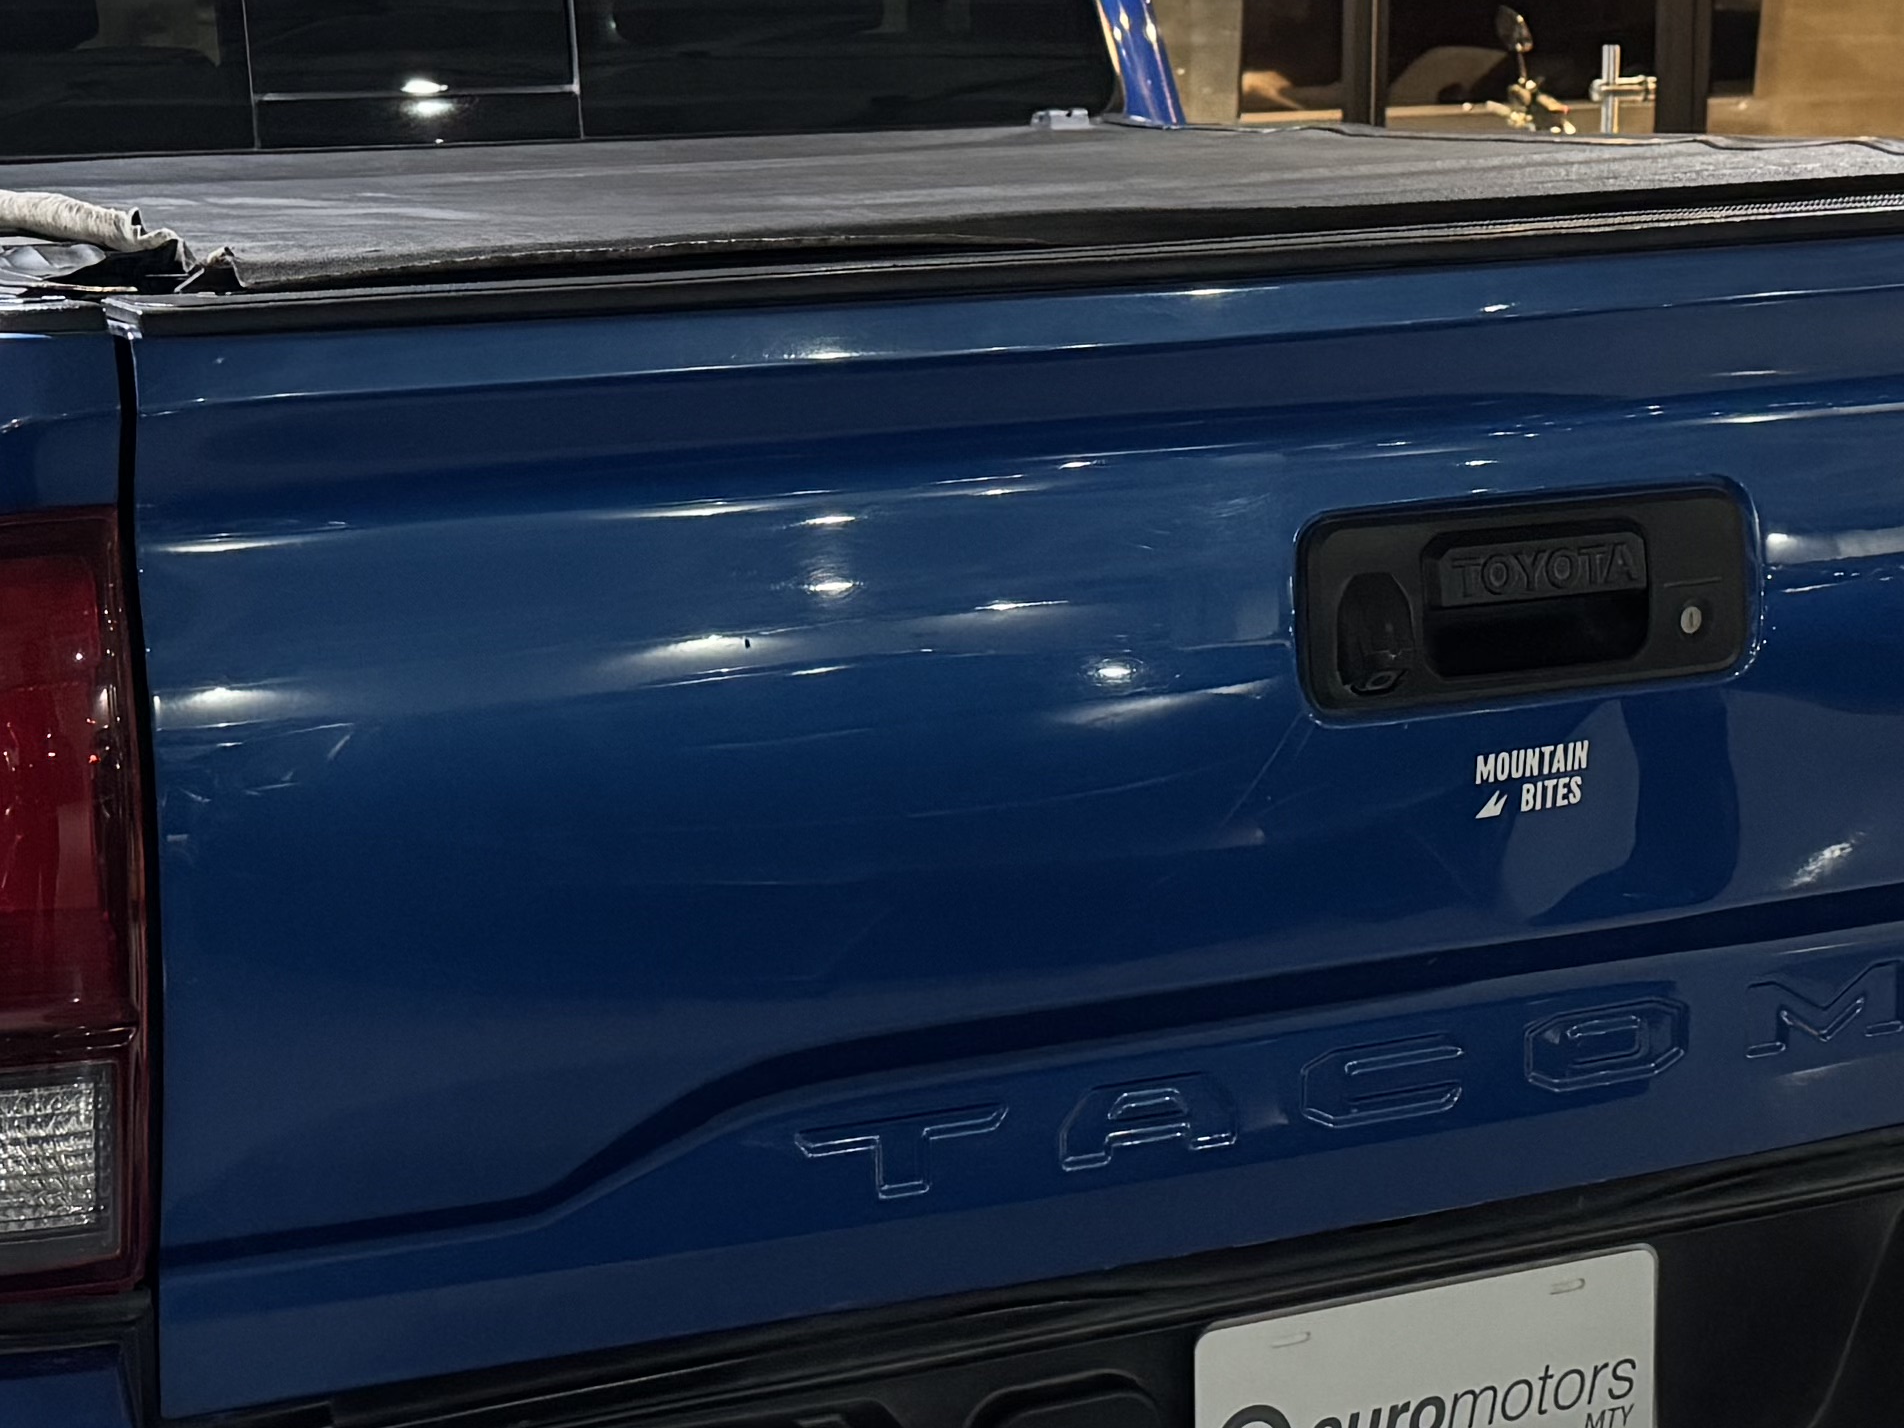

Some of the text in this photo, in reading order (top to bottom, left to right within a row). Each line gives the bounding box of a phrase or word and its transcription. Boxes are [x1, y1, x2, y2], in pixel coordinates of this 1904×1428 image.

[1451, 542, 1640, 598] TOYOTA
[1475, 740, 1589, 785] MOUNTAIN
[1520, 776, 1583, 812] BITES
